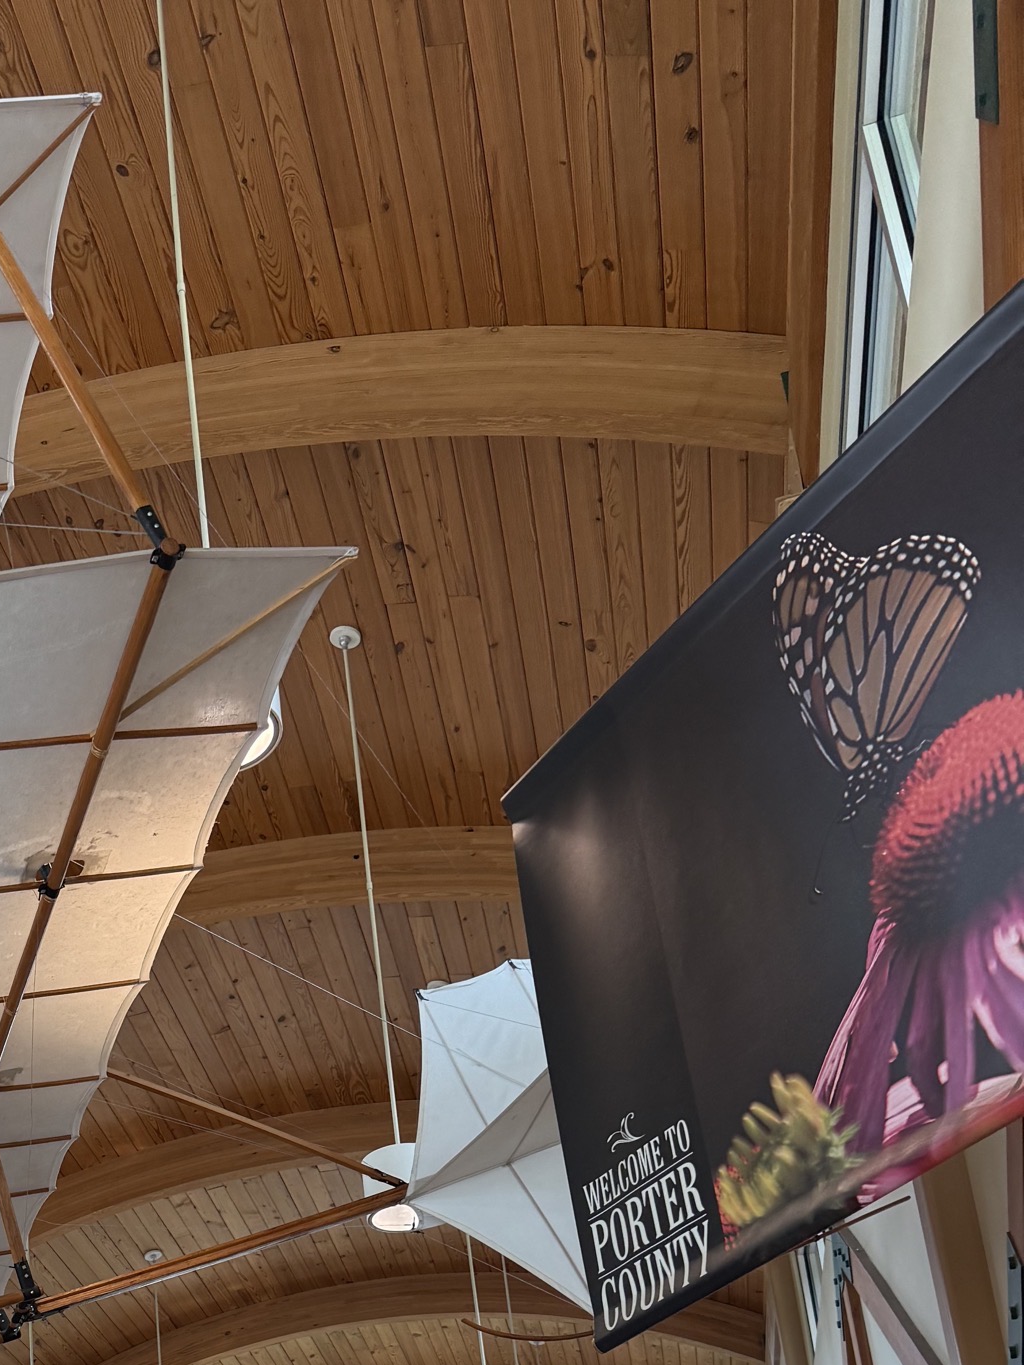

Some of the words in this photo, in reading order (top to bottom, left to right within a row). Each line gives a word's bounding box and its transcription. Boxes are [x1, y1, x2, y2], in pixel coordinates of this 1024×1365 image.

[582, 1136, 664, 1214] WELCOME
[664, 1119, 691, 1159] TO
[590, 1162, 705, 1275] PORTER
[601, 1220, 709, 1331] COUNTY
